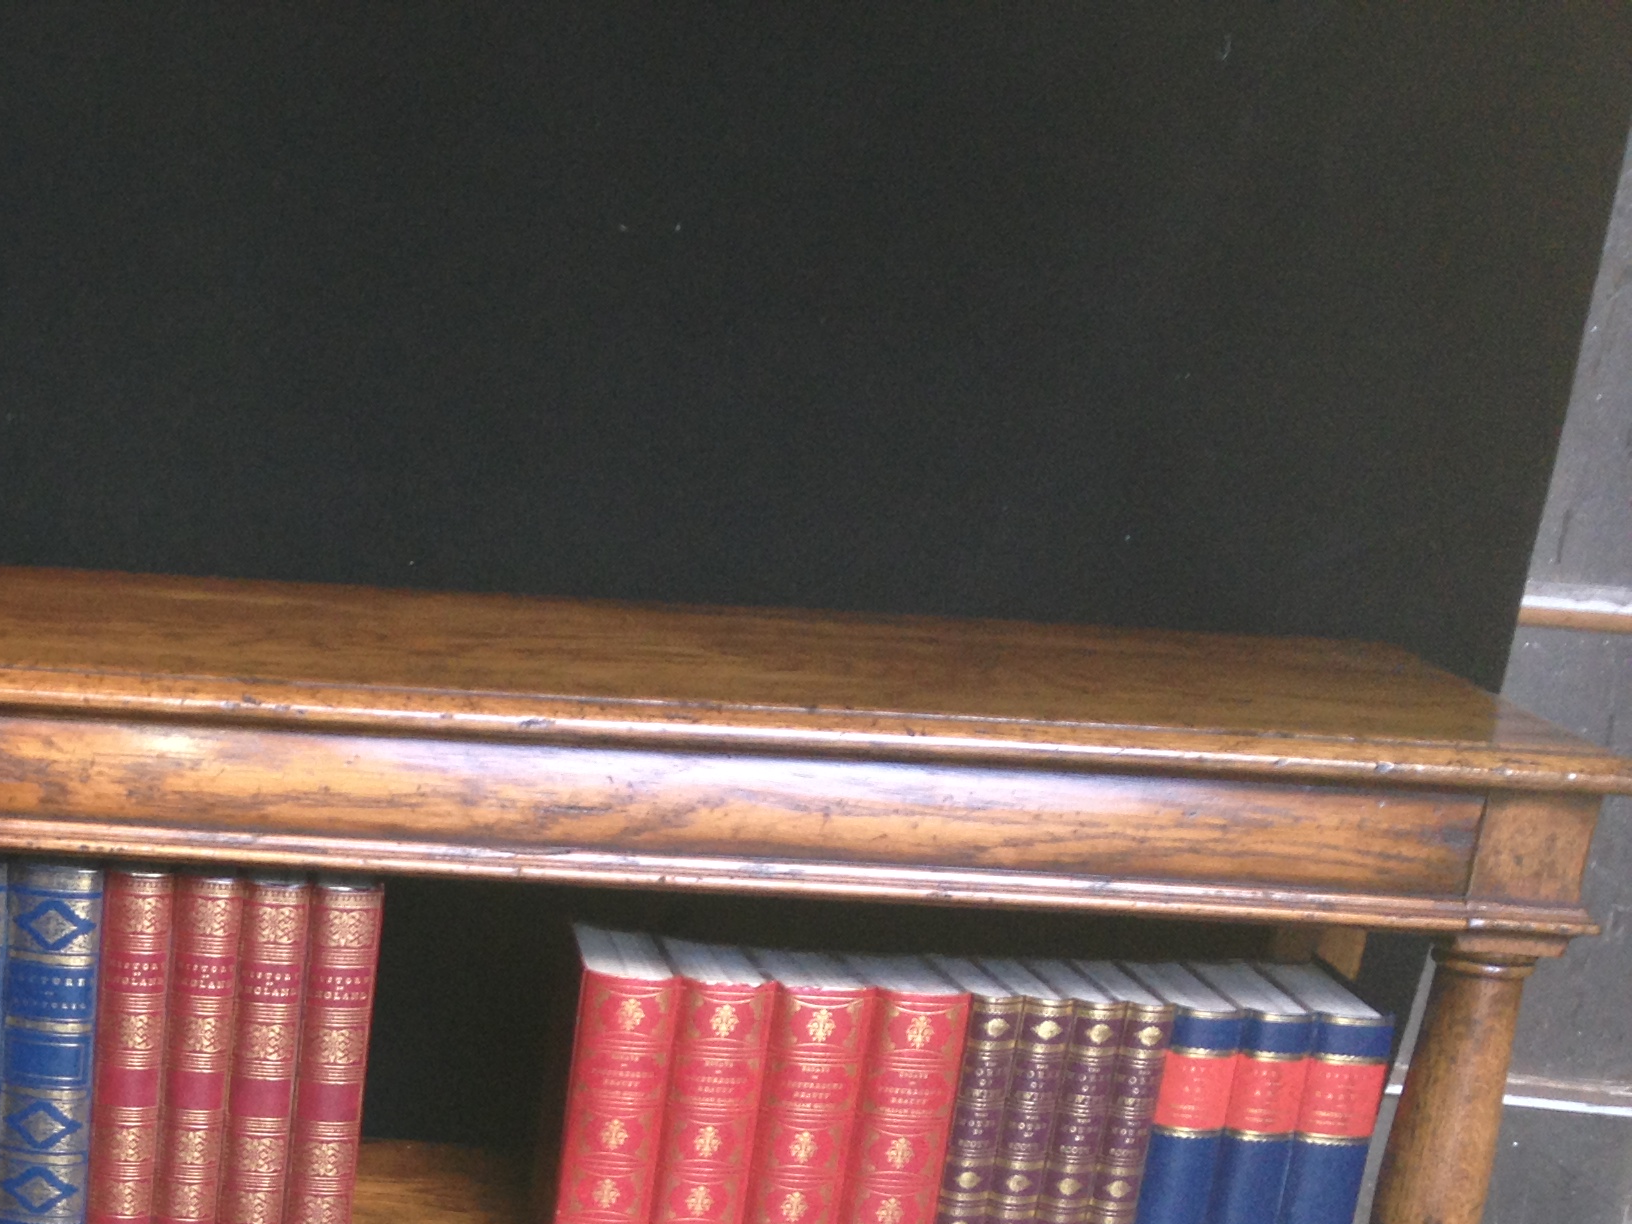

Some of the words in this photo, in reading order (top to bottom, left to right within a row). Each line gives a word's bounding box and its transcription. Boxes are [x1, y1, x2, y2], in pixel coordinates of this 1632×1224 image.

[109, 960, 167, 971] ISTORY
[176, 962, 234, 974] ISTORY
[243, 970, 300, 982] ISTORY
[311, 975, 370, 986] ISTORY
